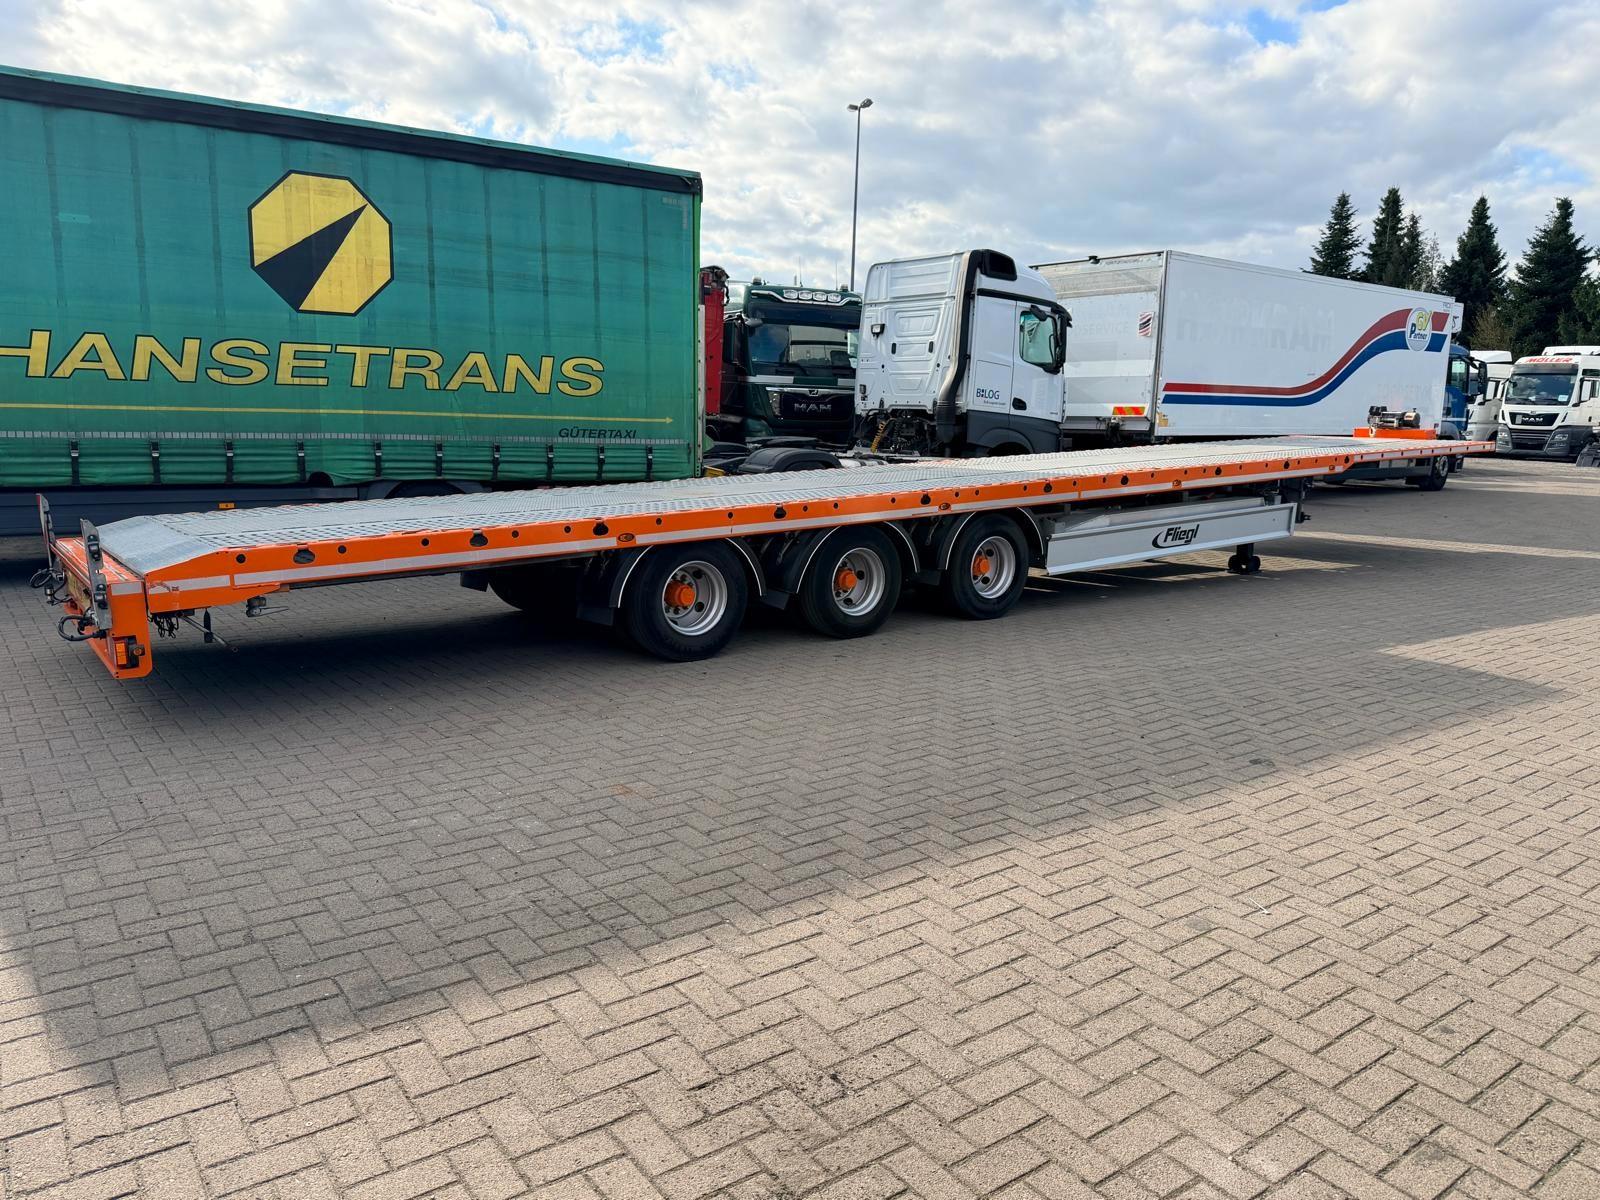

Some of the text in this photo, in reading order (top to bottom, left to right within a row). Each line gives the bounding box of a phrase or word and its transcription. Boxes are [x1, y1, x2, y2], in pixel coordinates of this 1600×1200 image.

[0, 329, 605, 397] HANSETRANS
[794, 402, 832, 412] MAN
[558, 425, 637, 439] GÜTERTAXI
[1163, 524, 1200, 544] Fliegl
